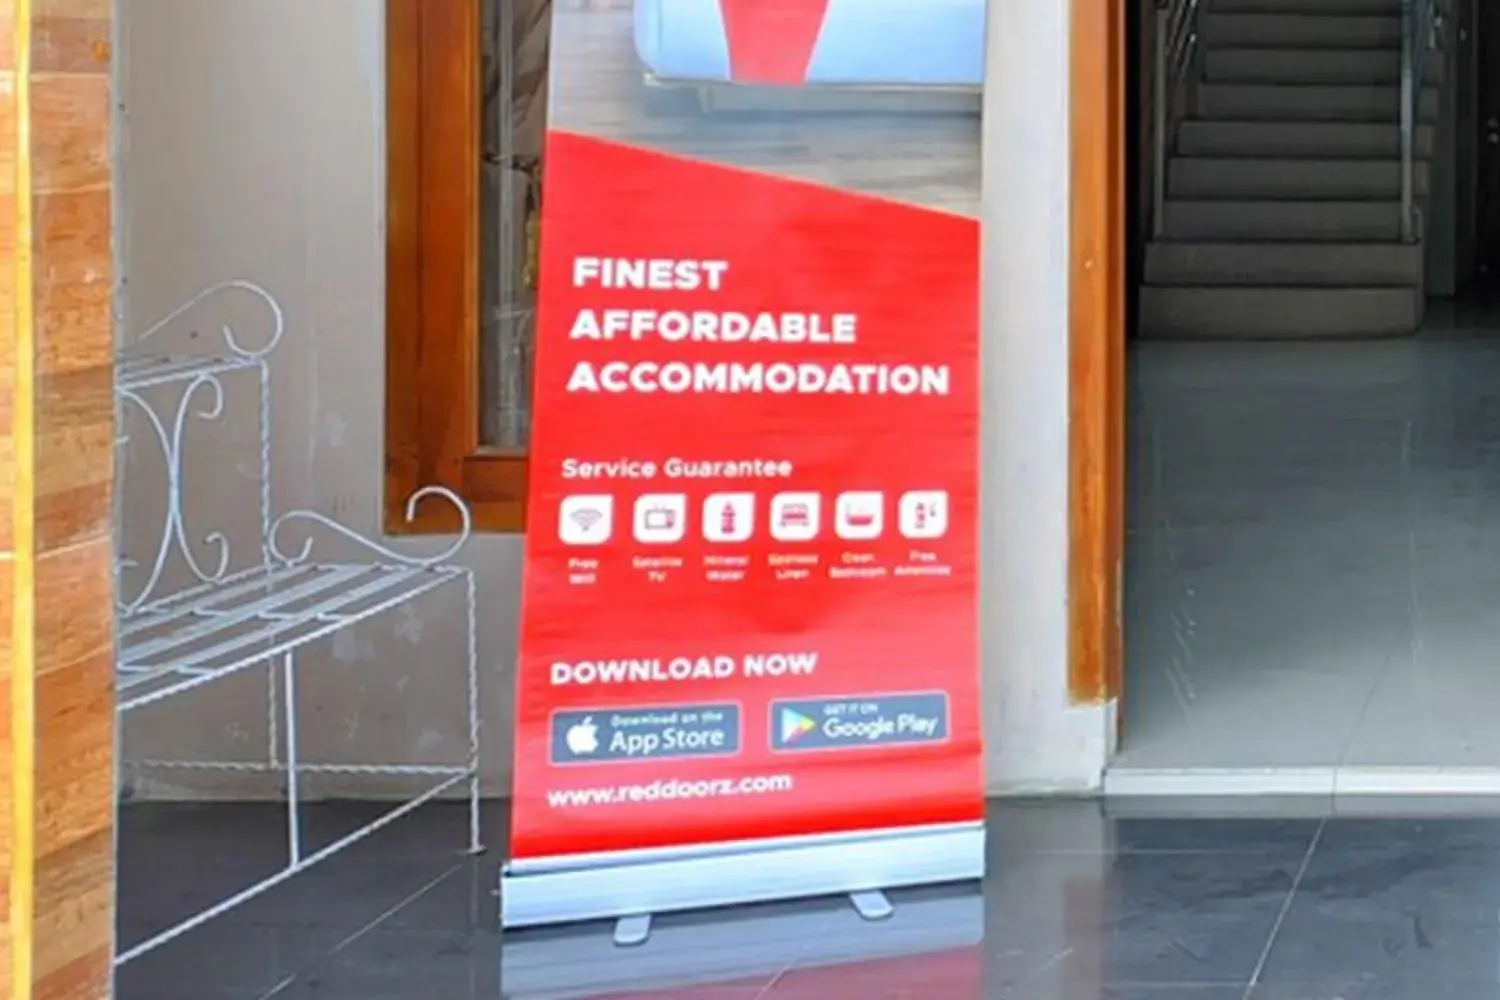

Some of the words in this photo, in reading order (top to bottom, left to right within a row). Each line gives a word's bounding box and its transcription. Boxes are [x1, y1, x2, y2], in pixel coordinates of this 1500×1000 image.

[573, 257, 728, 290] FINEST
[569, 309, 857, 343] AFFORDABLE
[566, 361, 950, 394] ACCOMMODATION
[562, 458, 656, 479] Service
[664, 458, 793, 478] Guarantee
[550, 656, 734, 685] DOWNLOAD
[743, 652, 818, 677] NOW
[610, 712, 678, 728] Download
[823, 717, 895, 740] Google
[897, 712, 939, 737] Play
[608, 730, 659, 756] App
[662, 727, 725, 750] Store
[547, 773, 792, 807] www.reddoorz.com
